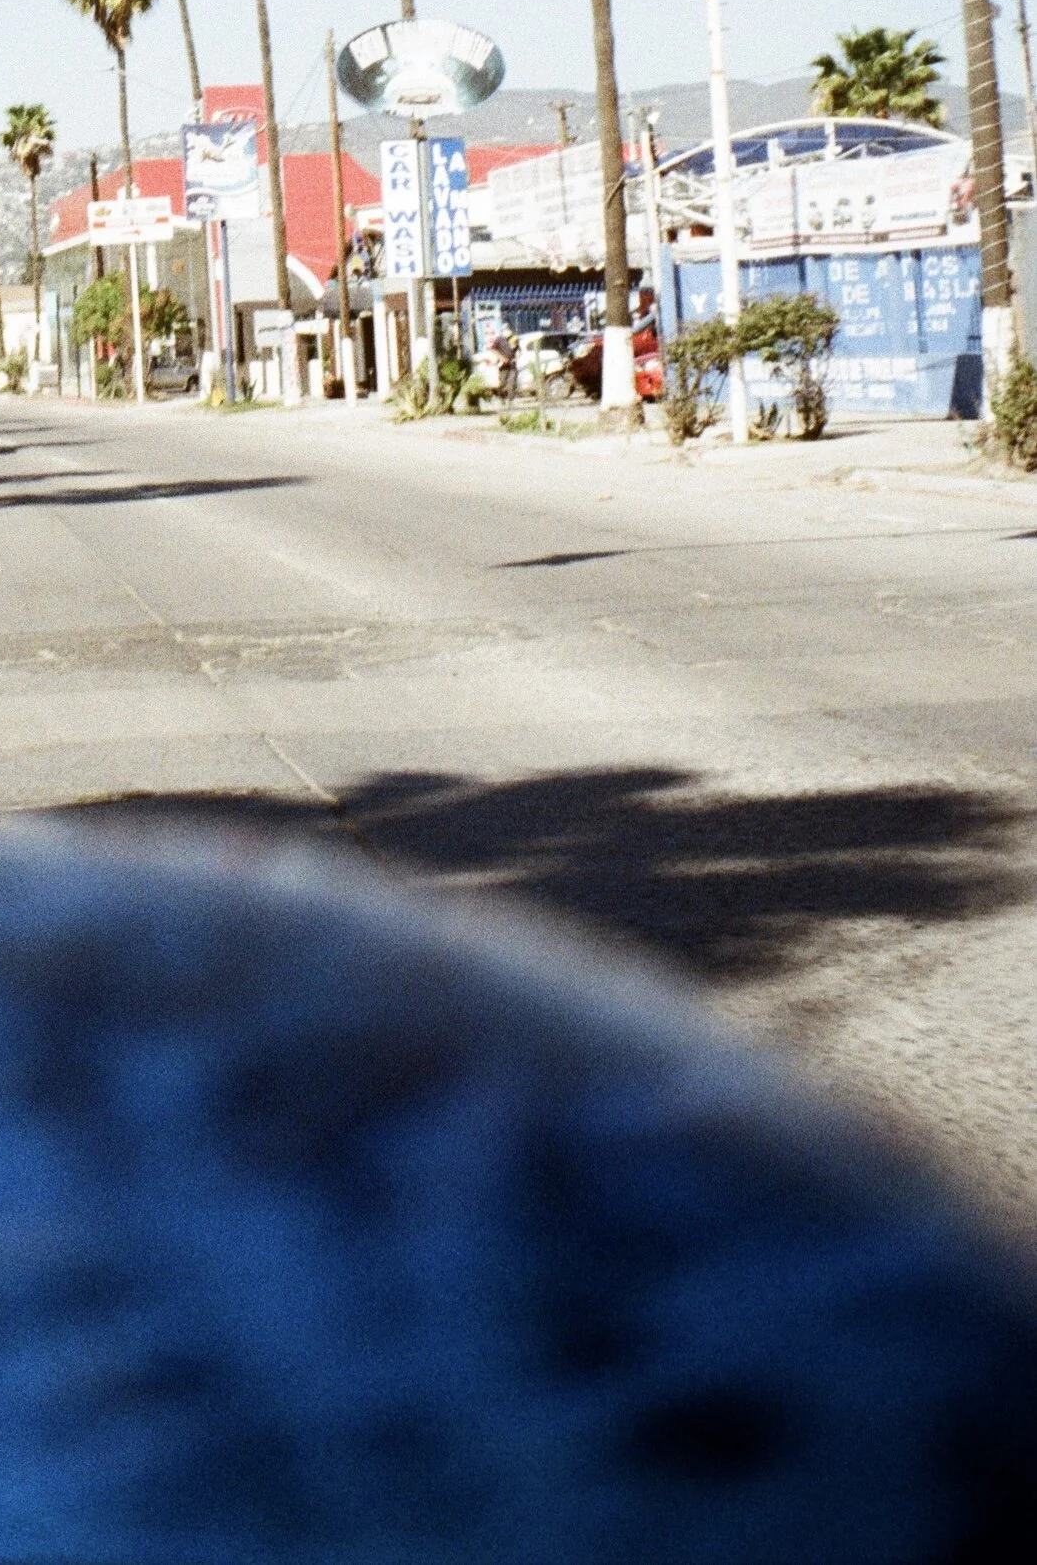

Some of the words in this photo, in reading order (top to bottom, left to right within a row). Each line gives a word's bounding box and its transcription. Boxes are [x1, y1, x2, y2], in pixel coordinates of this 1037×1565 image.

[389, 144, 411, 190] CAR
[389, 210, 417, 274] WASH
[432, 142, 454, 274] LAVADO
[449, 189, 471, 268] MANO
